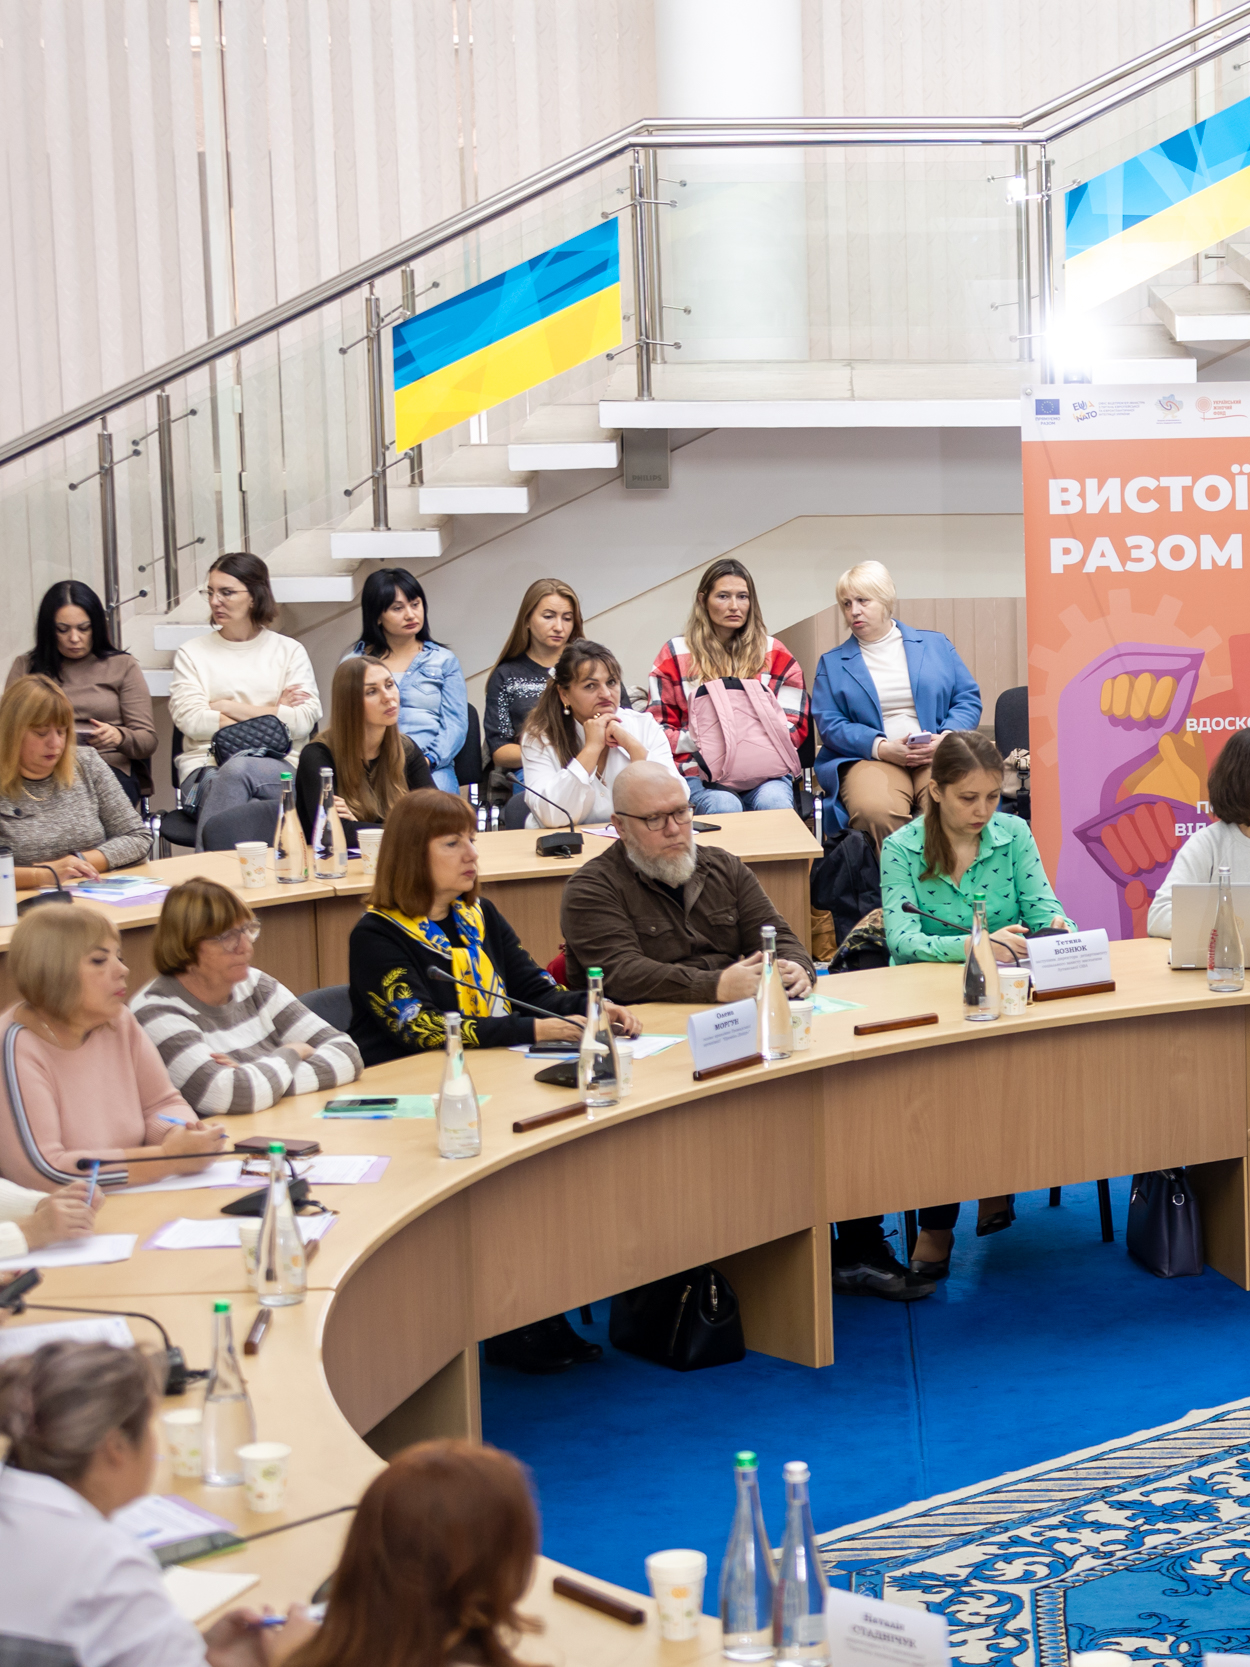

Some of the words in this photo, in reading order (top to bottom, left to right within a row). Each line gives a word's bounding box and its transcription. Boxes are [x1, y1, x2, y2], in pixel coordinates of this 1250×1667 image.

[1076, 410, 1098, 422] NATO
[1050, 533, 1243, 574] РАЗОМ
[1056, 938, 1082, 946] Тетяна
[1054, 945, 1088, 955] ВОЗНЮК
[716, 1010, 735, 1019] Олена
